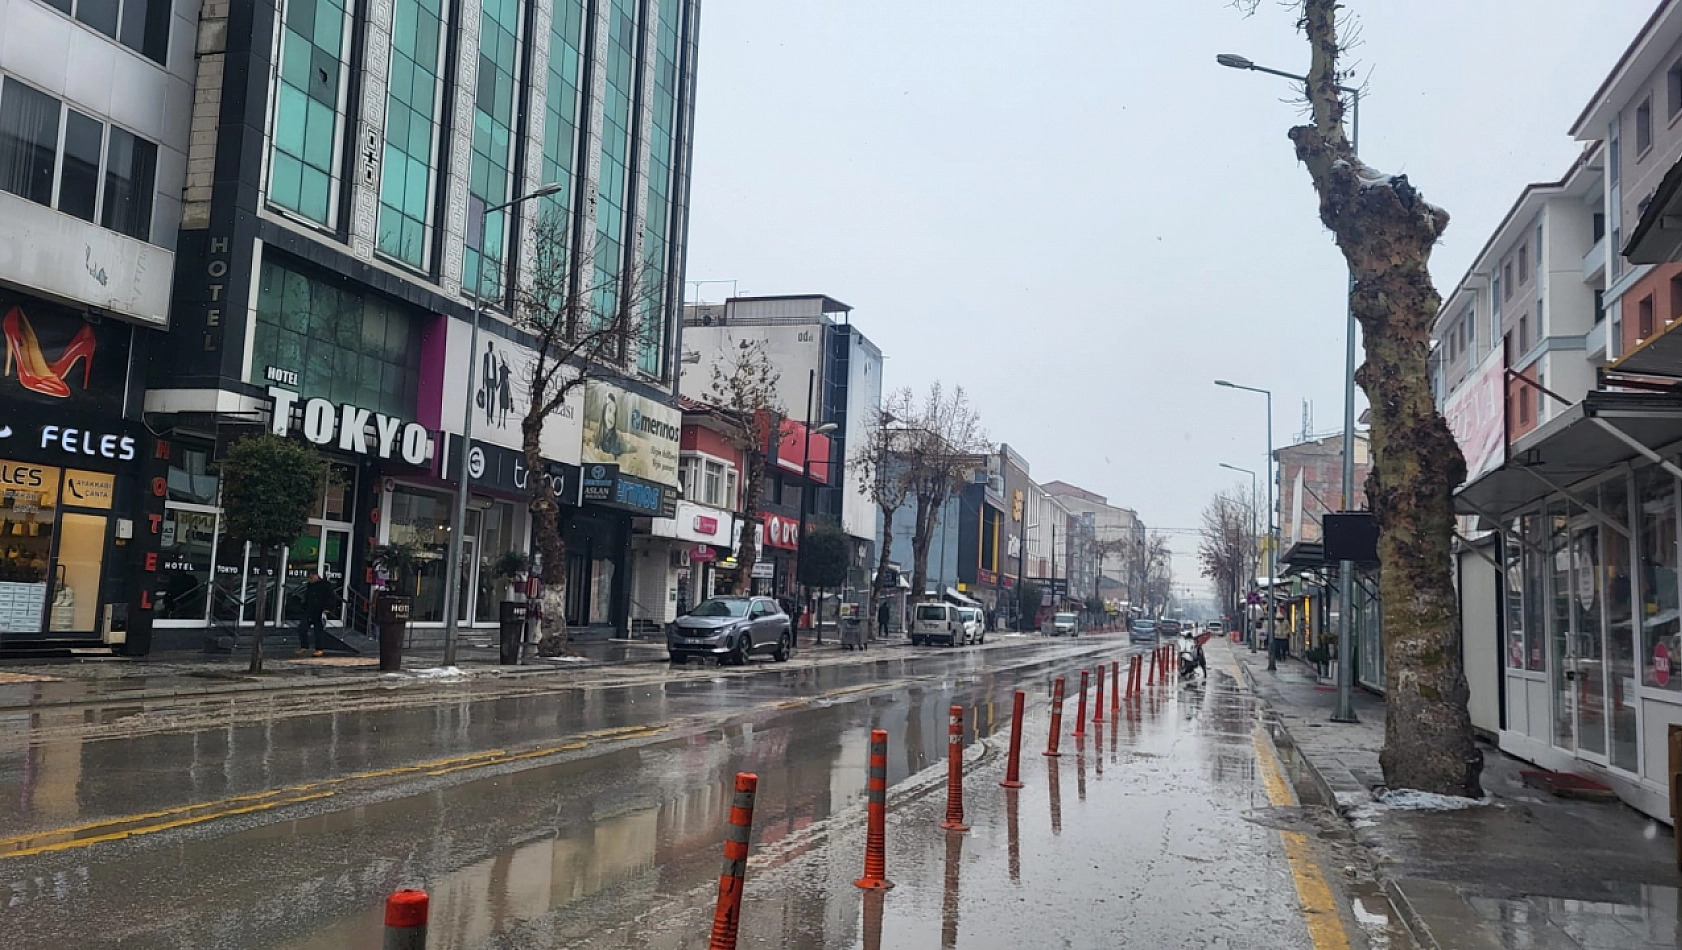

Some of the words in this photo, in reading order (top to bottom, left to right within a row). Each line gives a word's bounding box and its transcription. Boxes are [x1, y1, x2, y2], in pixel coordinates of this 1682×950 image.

[203, 237, 229, 352] HOTEL
[268, 366, 298, 386] HOTEL
[268, 386, 428, 464] TOKYO
[641, 415, 679, 442] merinos
[41, 425, 135, 460] FELES
[0, 465, 42, 486] LES
[514, 458, 564, 497] trnd
[140, 440, 171, 609] HOTEL
[164, 562, 194, 571] HOTEL
[217, 565, 238, 574] TOKYO
[288, 569, 308, 578] HOTE
